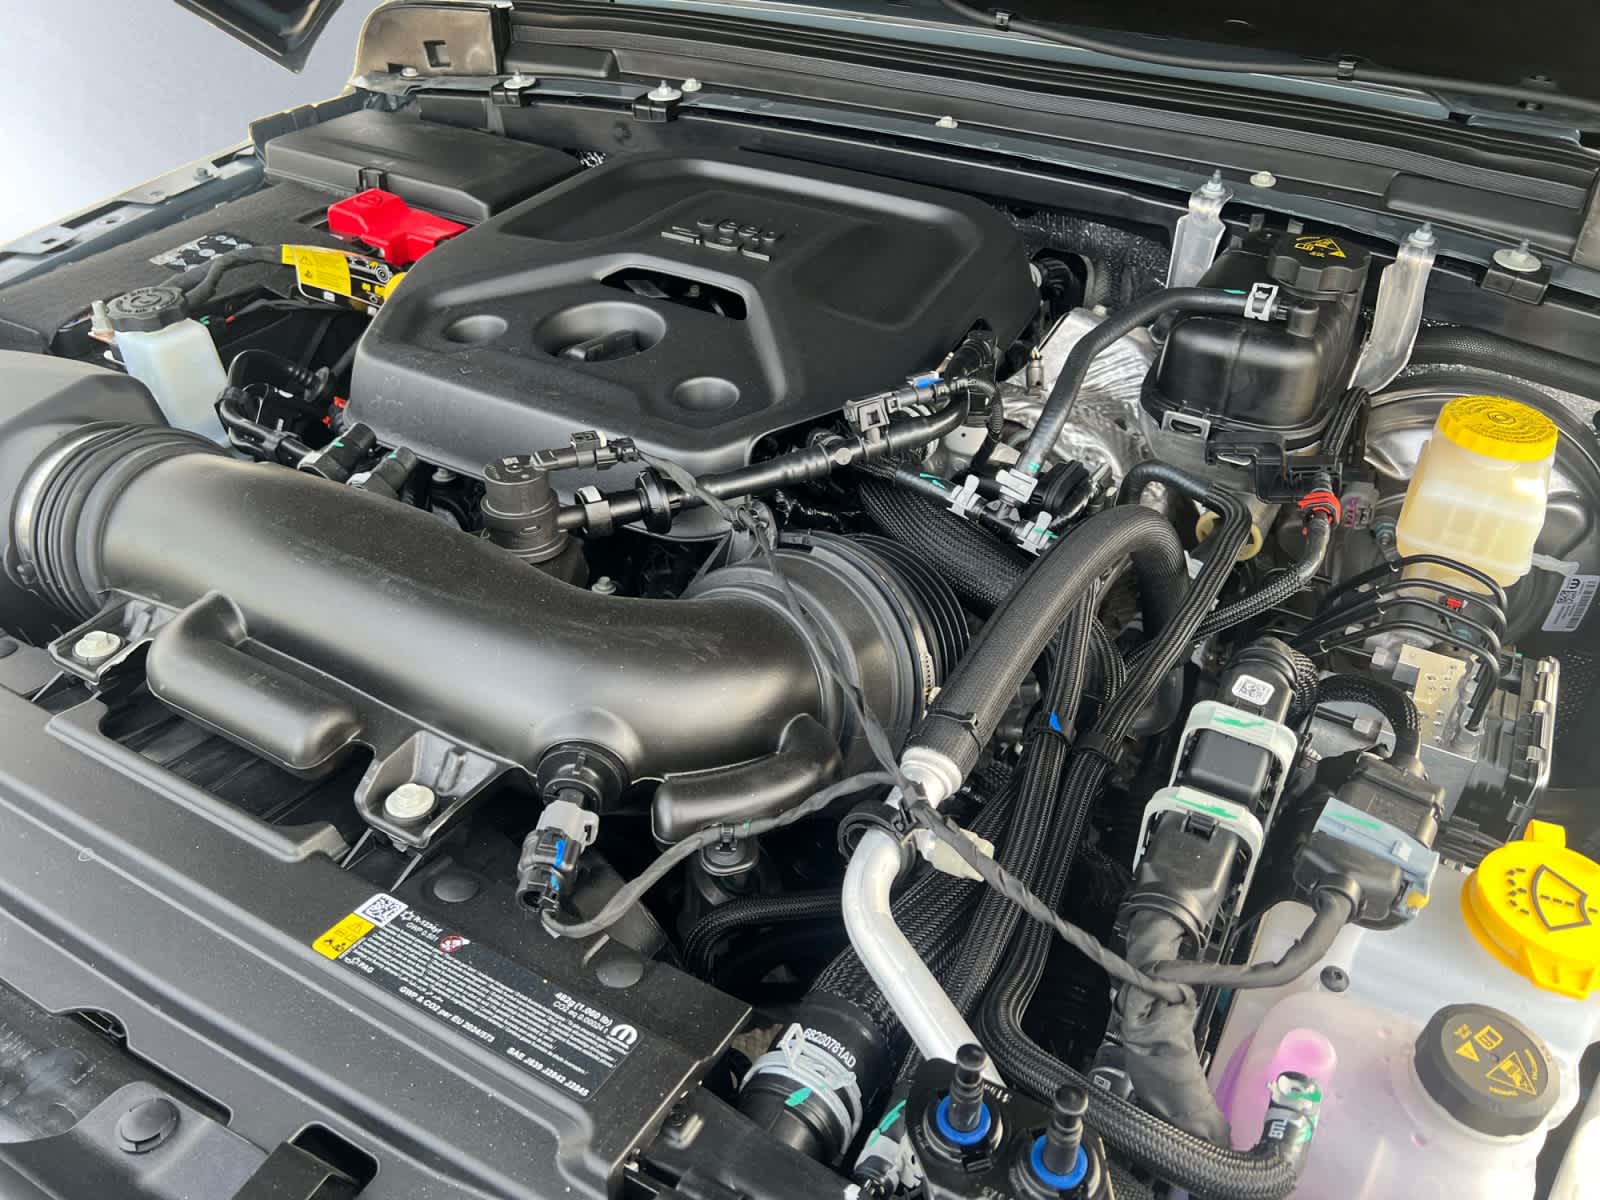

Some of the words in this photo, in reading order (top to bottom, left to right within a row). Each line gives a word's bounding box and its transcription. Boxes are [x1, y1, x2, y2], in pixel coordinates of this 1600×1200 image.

[399, 986, 418, 998] GWP
[423, 999, 440, 1012] CO2
[450, 1015, 465, 1025] EU
[553, 1000, 569, 1013] CO2
[506, 1047, 526, 1061] SAE
